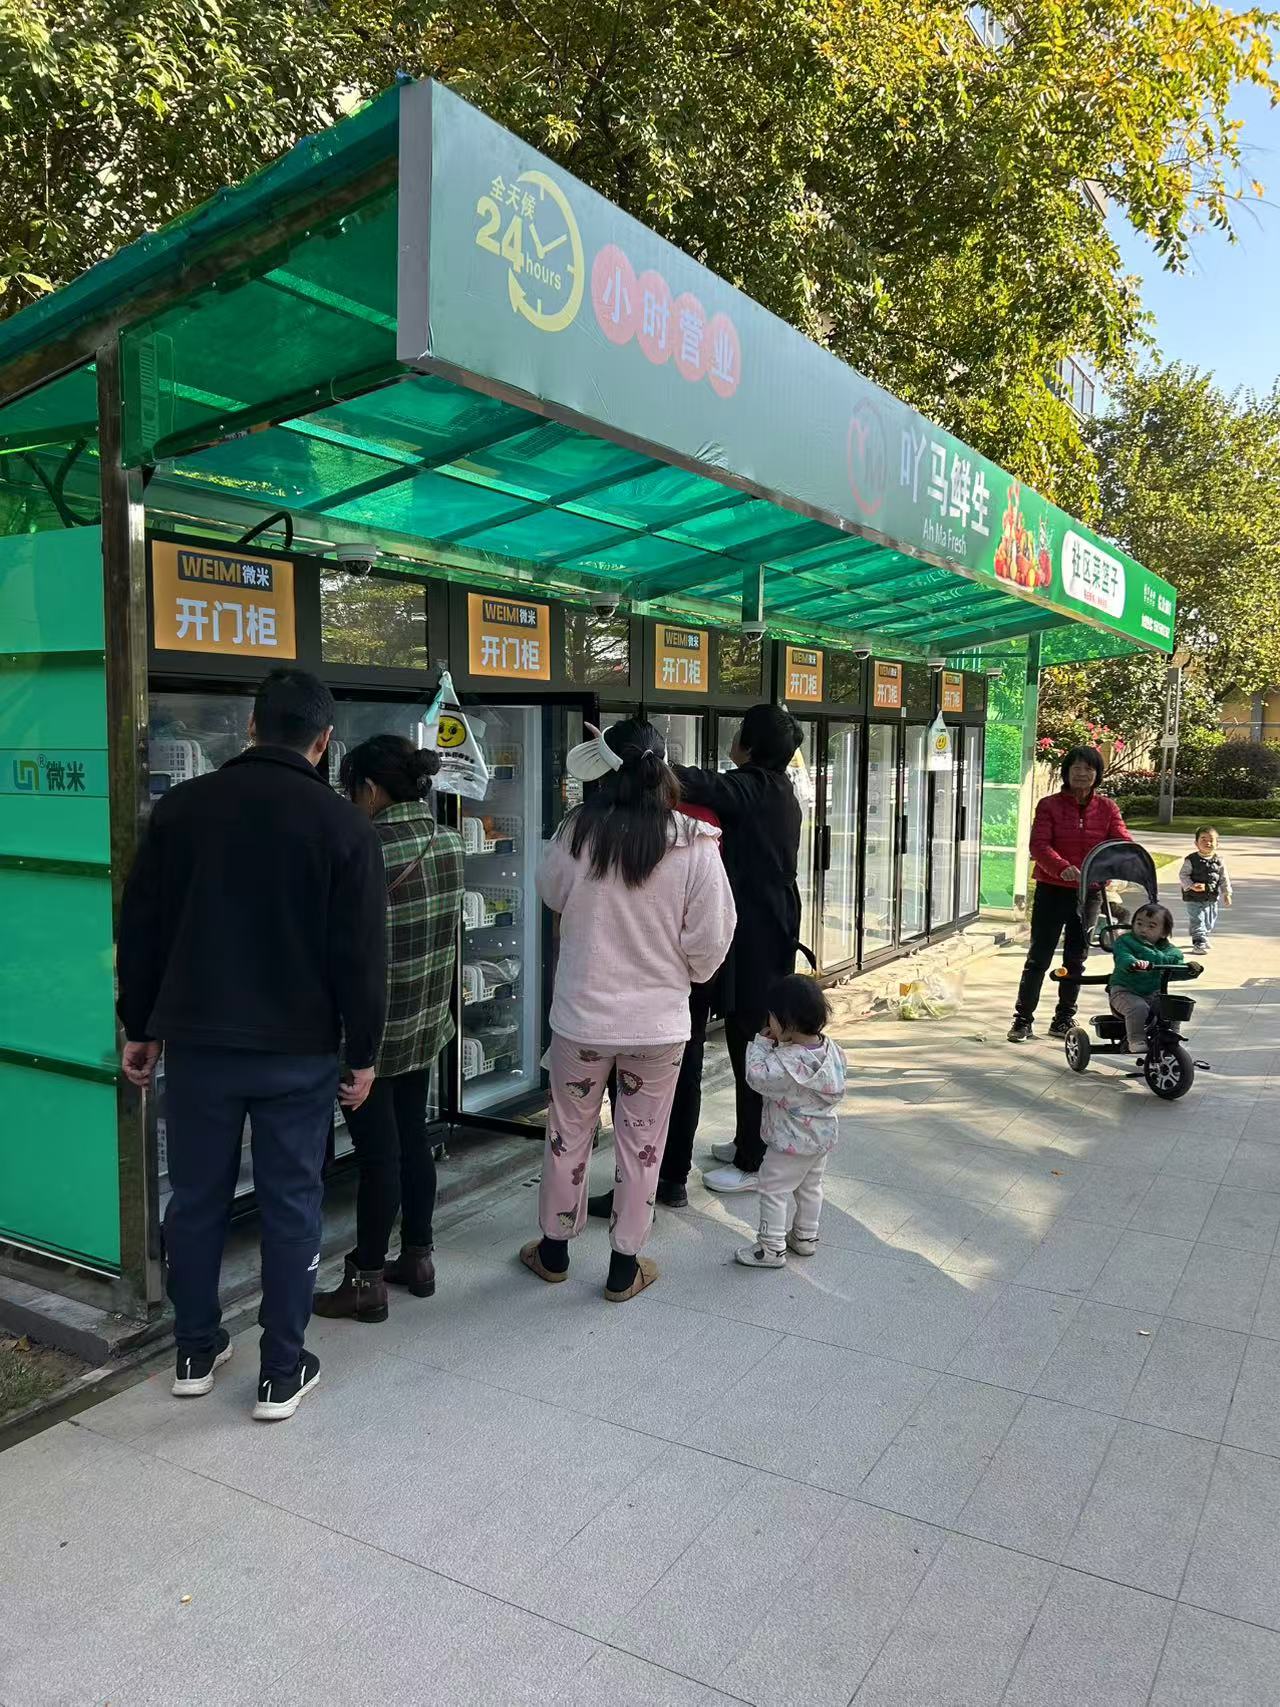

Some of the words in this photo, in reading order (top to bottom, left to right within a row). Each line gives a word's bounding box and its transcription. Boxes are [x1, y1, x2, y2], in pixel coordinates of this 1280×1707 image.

[490, 175, 536, 220] 全天候
[476, 196, 524, 273] 24
[526, 252, 561, 290] hours
[602, 266, 735, 384] 小时营业
[900, 426, 990, 537] 吖马鲜生
[922, 518, 934, 542] Ah
[935, 523, 947, 547] Ma
[948, 529, 967, 556] Fresh
[176, 598, 277, 645] 开门柜
[481, 635, 540, 670] 开门柜
[662, 657, 701, 685] 开门柜
[790, 673, 817, 695] 开门柜
[46, 760, 86, 792] 微米
